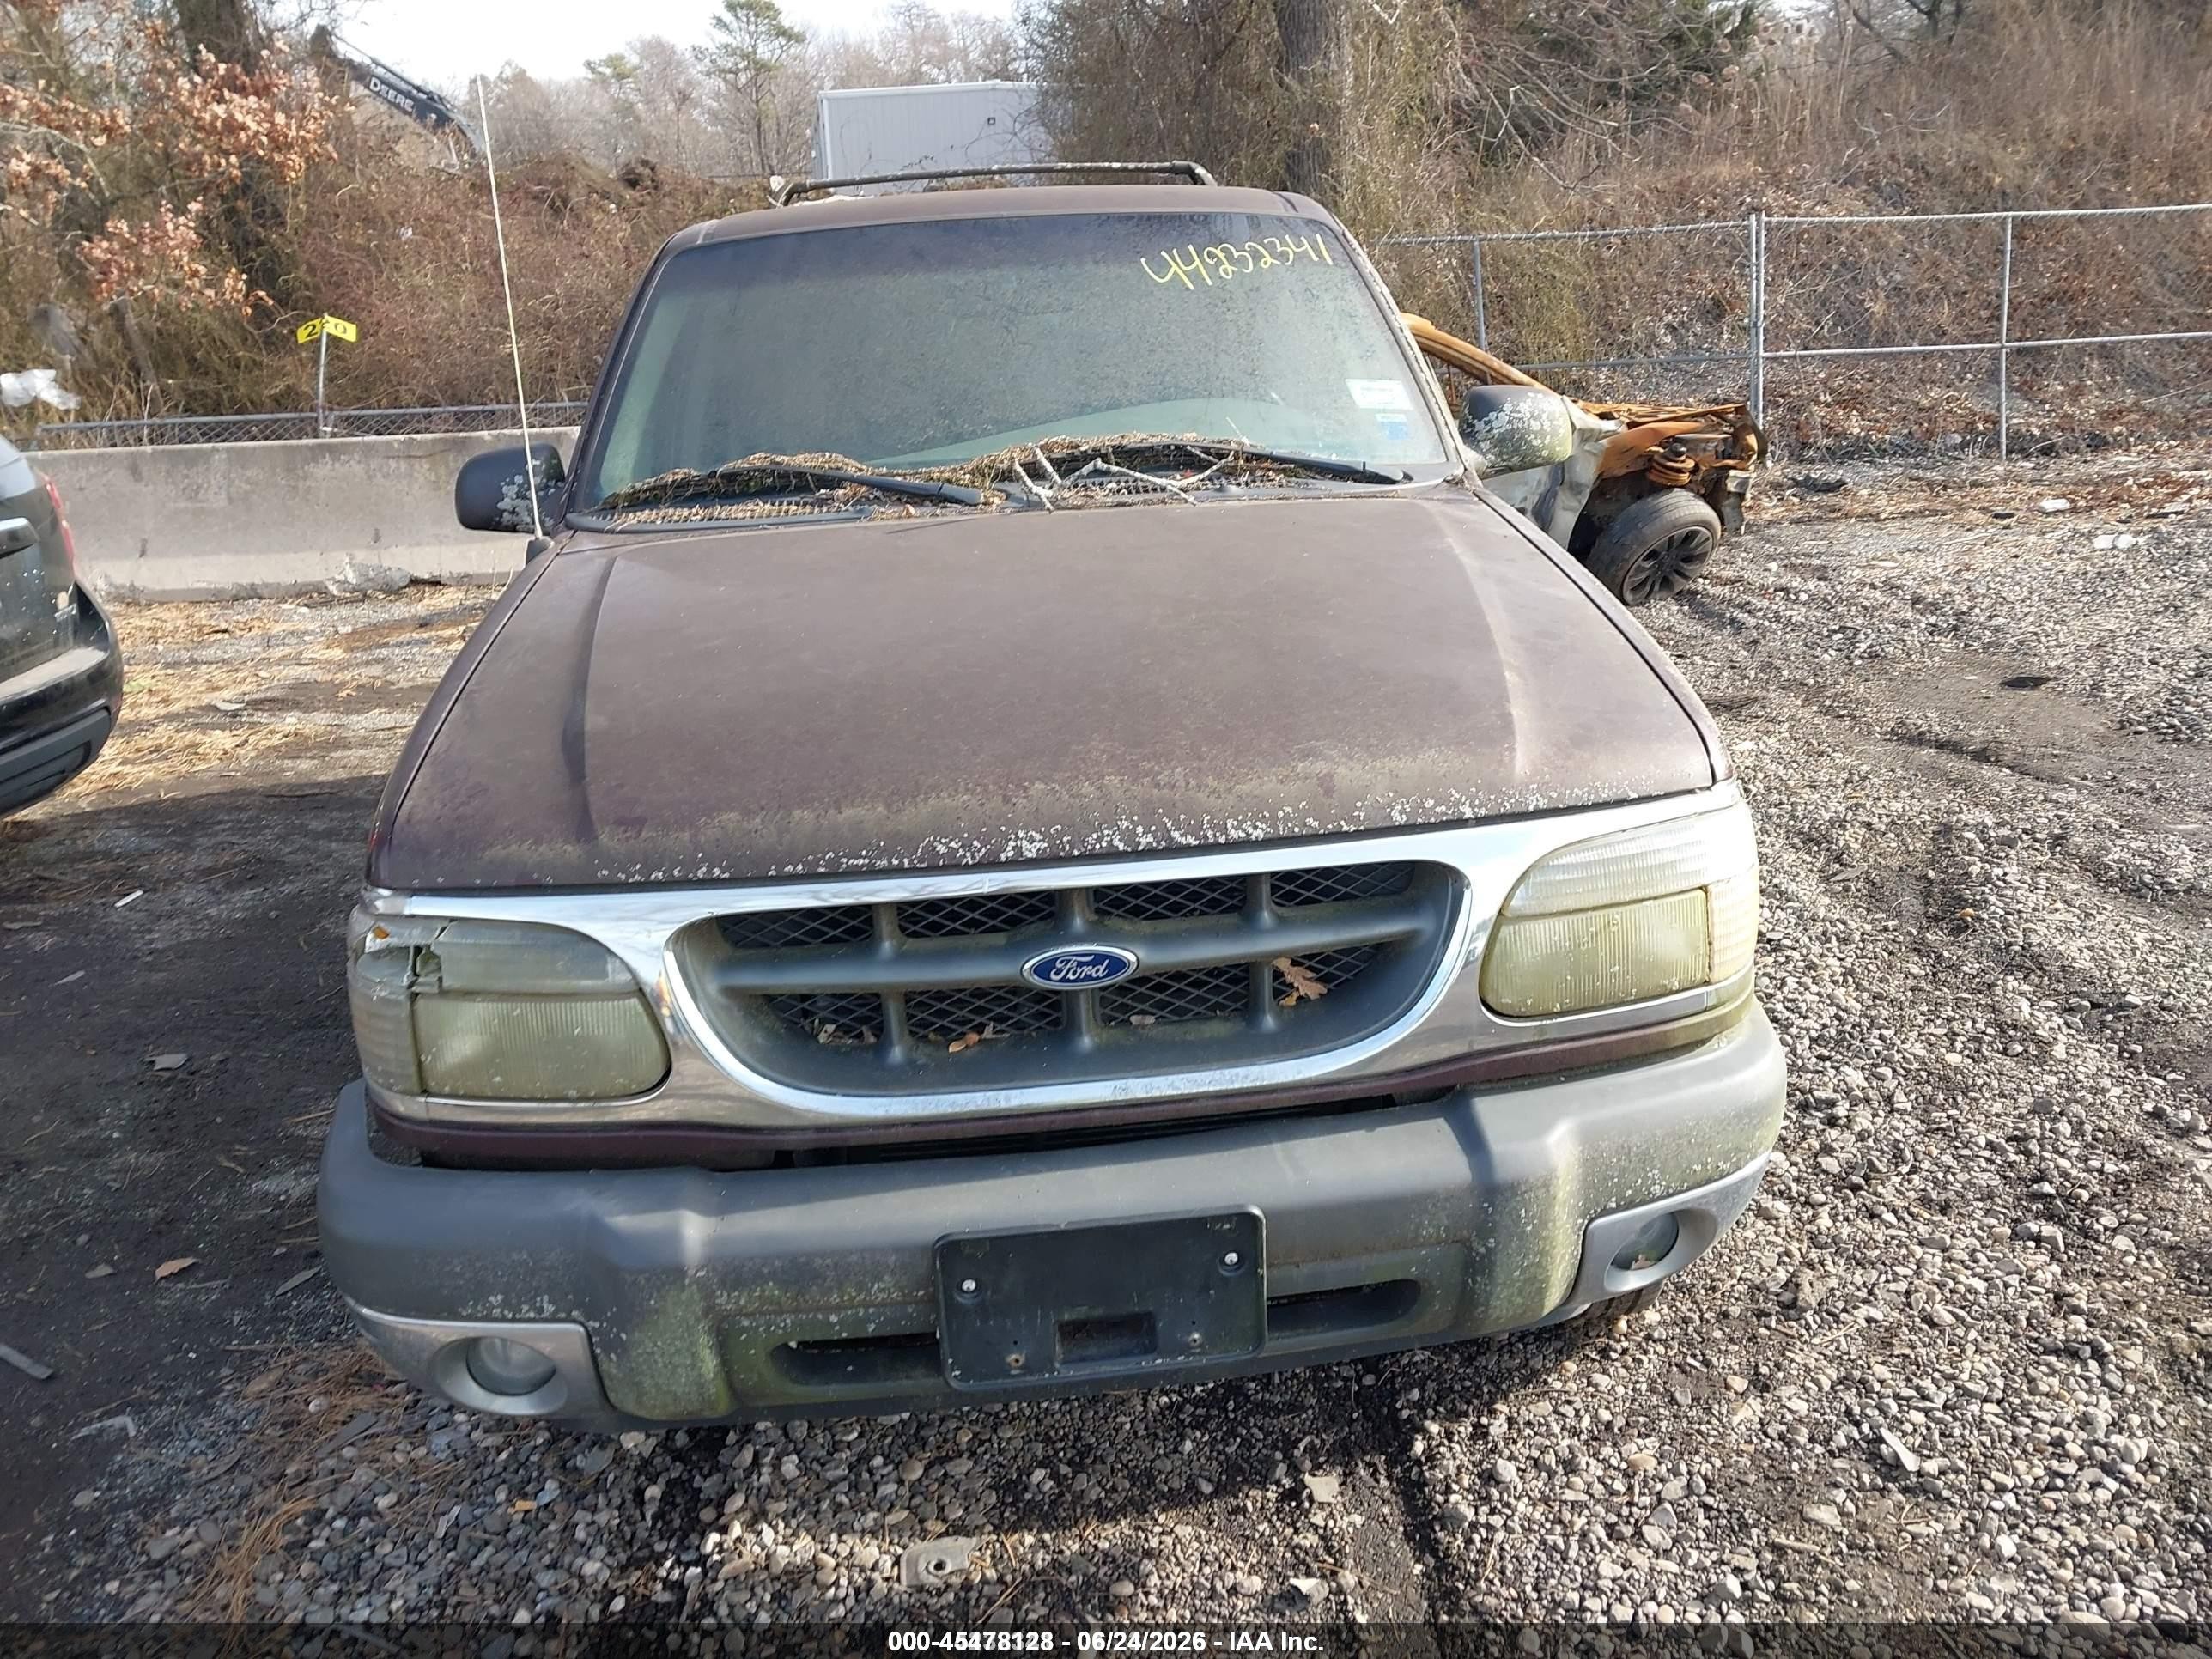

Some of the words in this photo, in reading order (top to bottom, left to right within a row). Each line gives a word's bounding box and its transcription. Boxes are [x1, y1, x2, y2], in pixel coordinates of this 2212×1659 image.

[369, 76, 414, 112] DEERE
[1140, 233, 1334, 290] 44232341
[1049, 954, 1109, 981] Ford
